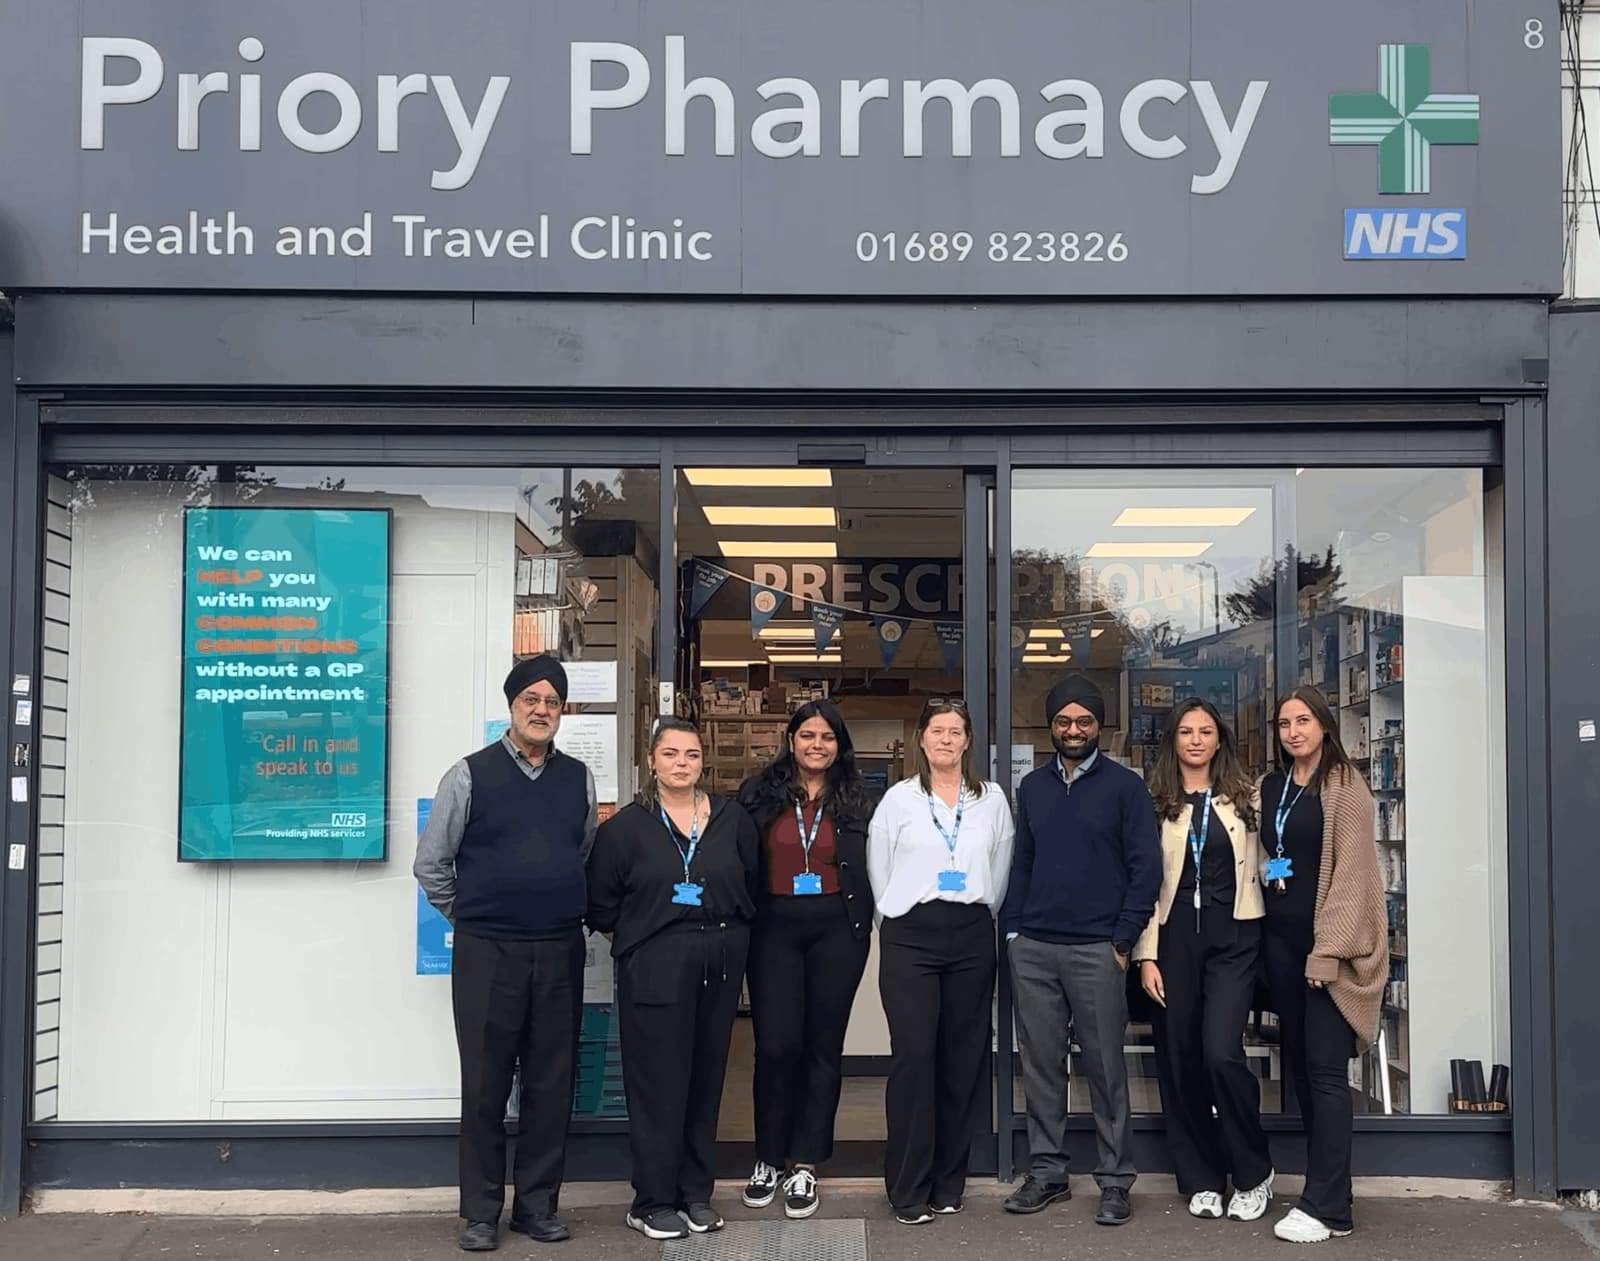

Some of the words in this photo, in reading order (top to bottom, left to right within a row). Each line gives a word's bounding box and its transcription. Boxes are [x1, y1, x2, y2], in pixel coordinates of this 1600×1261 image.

[1523, 19, 1545, 50] 8
[80, 36, 512, 191] Priory
[569, 35, 1270, 194] Pharmacy
[81, 211, 255, 255] Health
[274, 212, 373, 257] and
[392, 214, 549, 259] Travel
[569, 215, 714, 261] Clinic
[1348, 212, 1462, 255] NHS
[855, 231, 974, 263] 01689
[987, 232, 1130, 263] 823826
[197, 546, 238, 561] We
[245, 549, 292, 561] can
[197, 569, 263, 584] HELP
[268, 573, 316, 588] you
[196, 592, 254, 608] with
[261, 596, 332, 611] many
[196, 616, 317, 630] COMMON
[196, 639, 358, 654] CONDITIONS
[196, 661, 299, 677] without
[304, 666, 321, 677] a
[327, 662, 364, 677] GP
[195, 684, 365, 703] appointment
[261, 734, 296, 753] Call
[302, 735, 319, 753] in
[325, 735, 359, 753] and
[255, 758, 308, 779] speak
[315, 761, 333, 776] to
[332, 813, 366, 827] NHS
[265, 828, 309, 840] Providing
[309, 828, 329, 838] NHS
[330, 828, 367, 839] services
